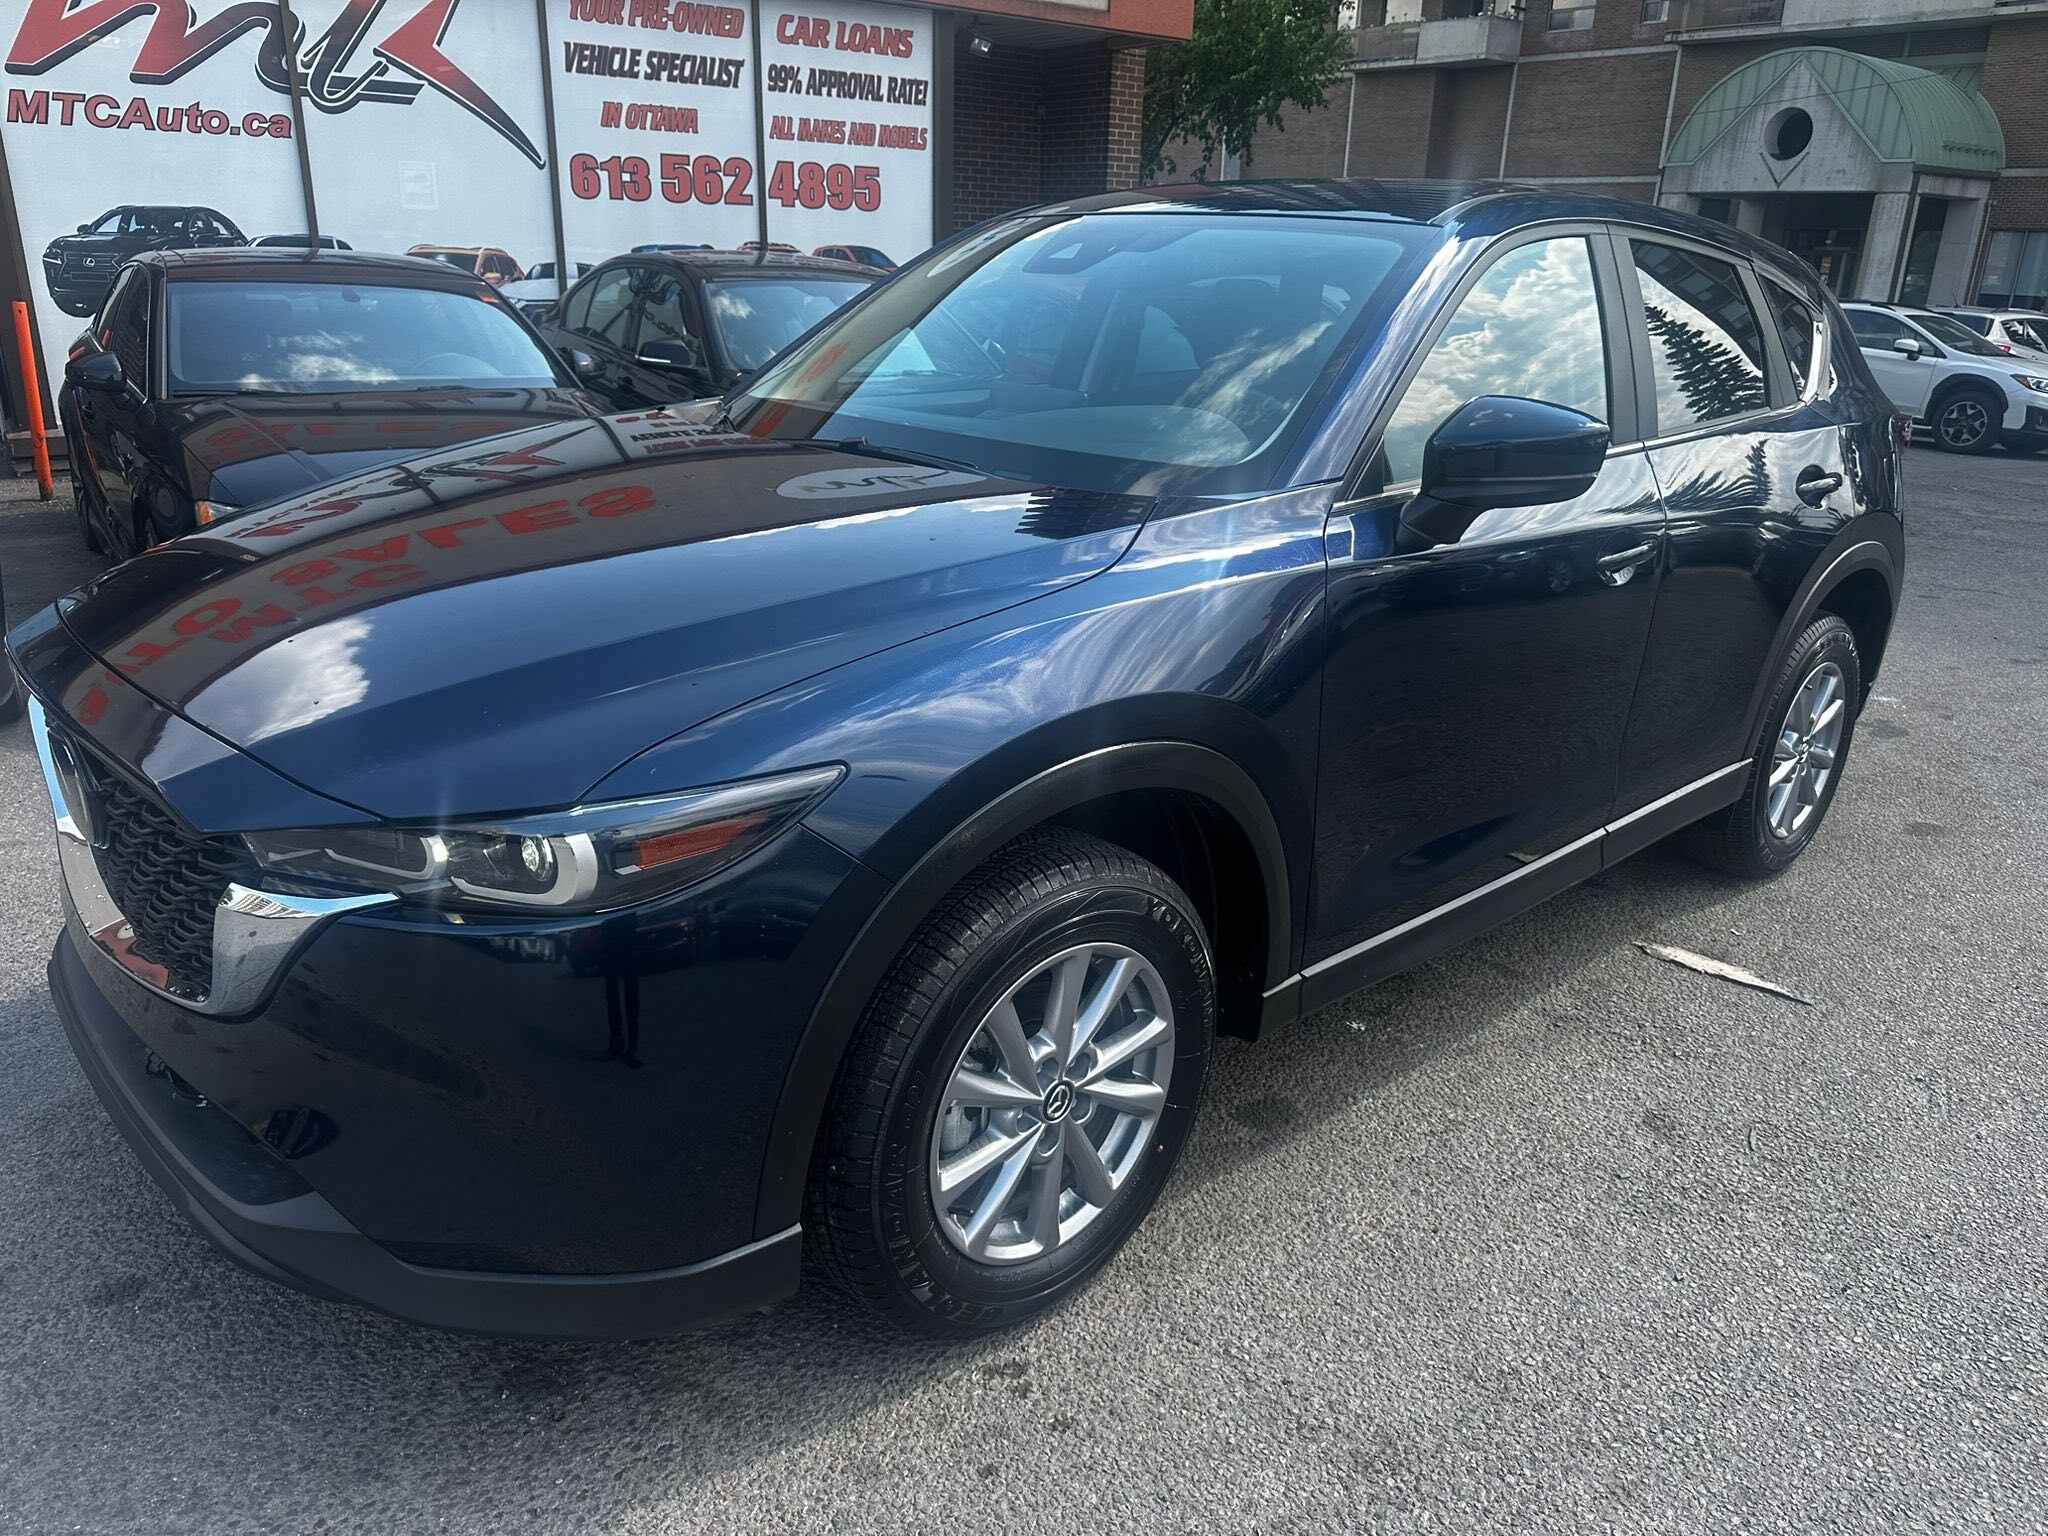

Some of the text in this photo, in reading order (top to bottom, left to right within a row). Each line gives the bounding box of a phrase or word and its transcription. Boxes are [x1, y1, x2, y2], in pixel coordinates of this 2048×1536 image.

[569, 0, 745, 39] YOUR PRE-OWNED
[776, 14, 914, 59] CAR LOANS
[563, 41, 746, 89] VEHICLE SPECIALIST
[767, 63, 929, 107] 99% APPROVAL RATE!
[7, 89, 292, 139] MTCAuto.ca
[600, 101, 699, 134] IN OTTAWA
[769, 115, 928, 151] ALL MAKES AND MODELS
[569, 153, 881, 212] 613 562 4895
